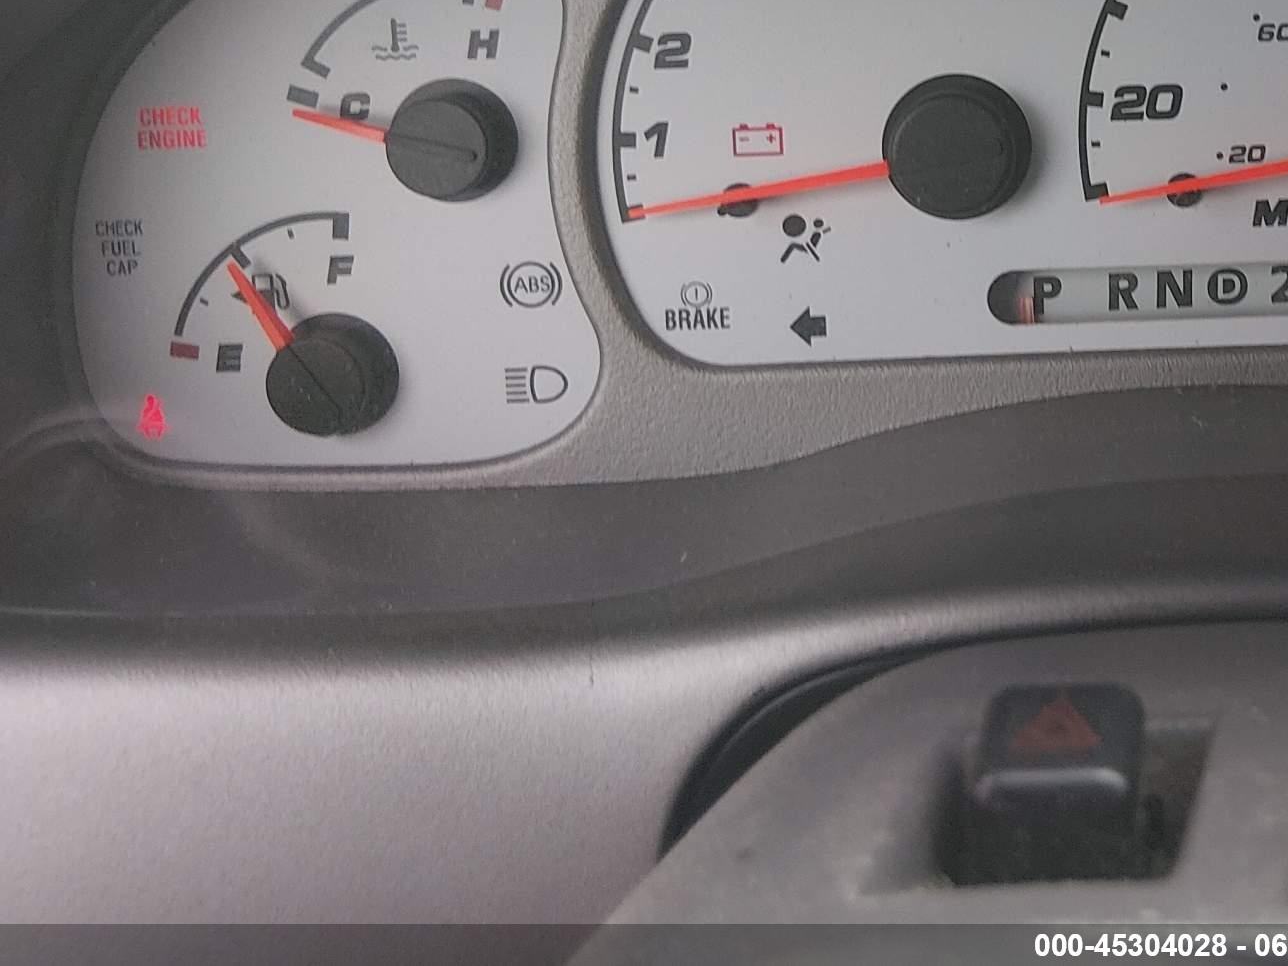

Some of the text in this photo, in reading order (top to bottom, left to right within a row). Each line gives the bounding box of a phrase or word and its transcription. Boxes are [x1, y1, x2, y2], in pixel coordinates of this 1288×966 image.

[467, 29, 500, 60] H
[653, 32, 692, 68] 2
[340, 93, 371, 121] C
[1110, 85, 1183, 120] 20
[138, 106, 202, 126] CHECK
[137, 129, 207, 150] ENGINE
[644, 121, 669, 159] 1
[1228, 145, 1266, 164] 20
[95, 219, 143, 236] CHECK
[101, 240, 141, 256] FUEL
[106, 260, 138, 276] CAP
[327, 255, 354, 285] F
[514, 273, 549, 293] ABS
[1033, 276, 1062, 315] P
[1108, 272, 1139, 311] R
[1156, 269, 1194, 308] N
[1207, 268, 1248, 305] D
[665, 308, 731, 331] BRAKE
[216, 343, 243, 373] E
